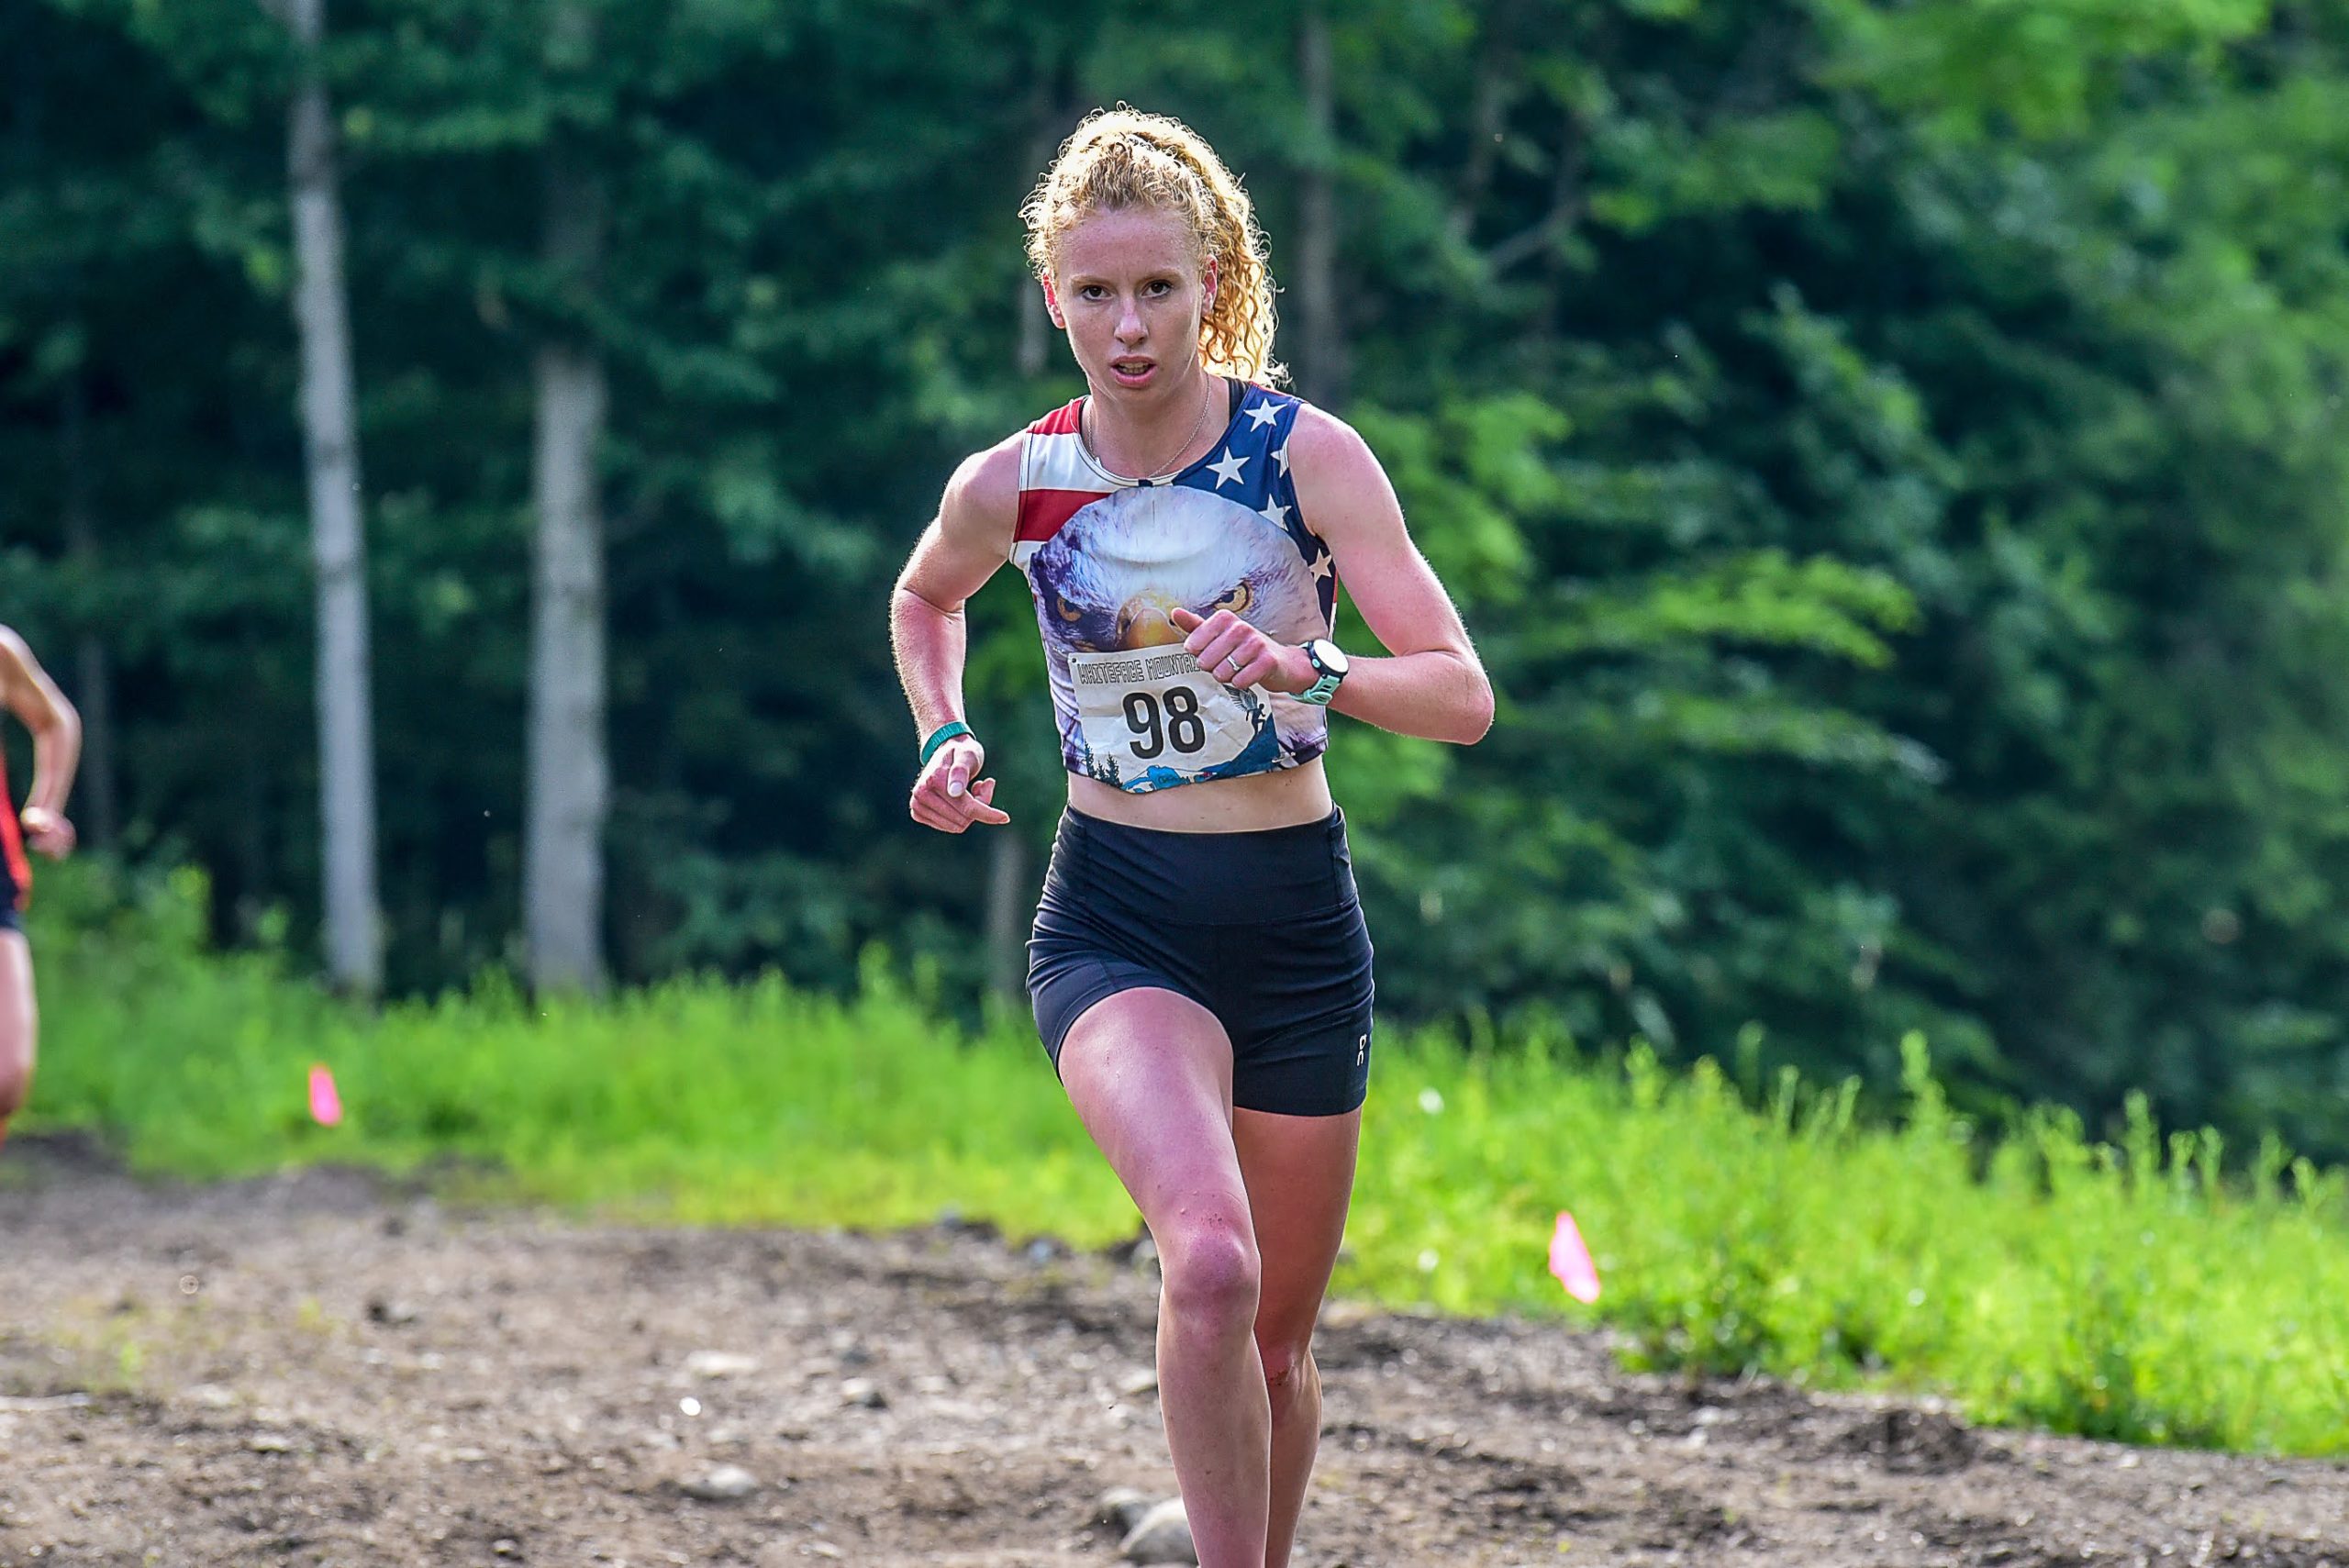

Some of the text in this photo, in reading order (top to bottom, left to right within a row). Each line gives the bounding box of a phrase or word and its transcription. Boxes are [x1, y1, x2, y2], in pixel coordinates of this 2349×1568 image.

[1077, 652, 1201, 684] WHITEFACE MOUNTAI
[1122, 685, 1206, 760] 98
